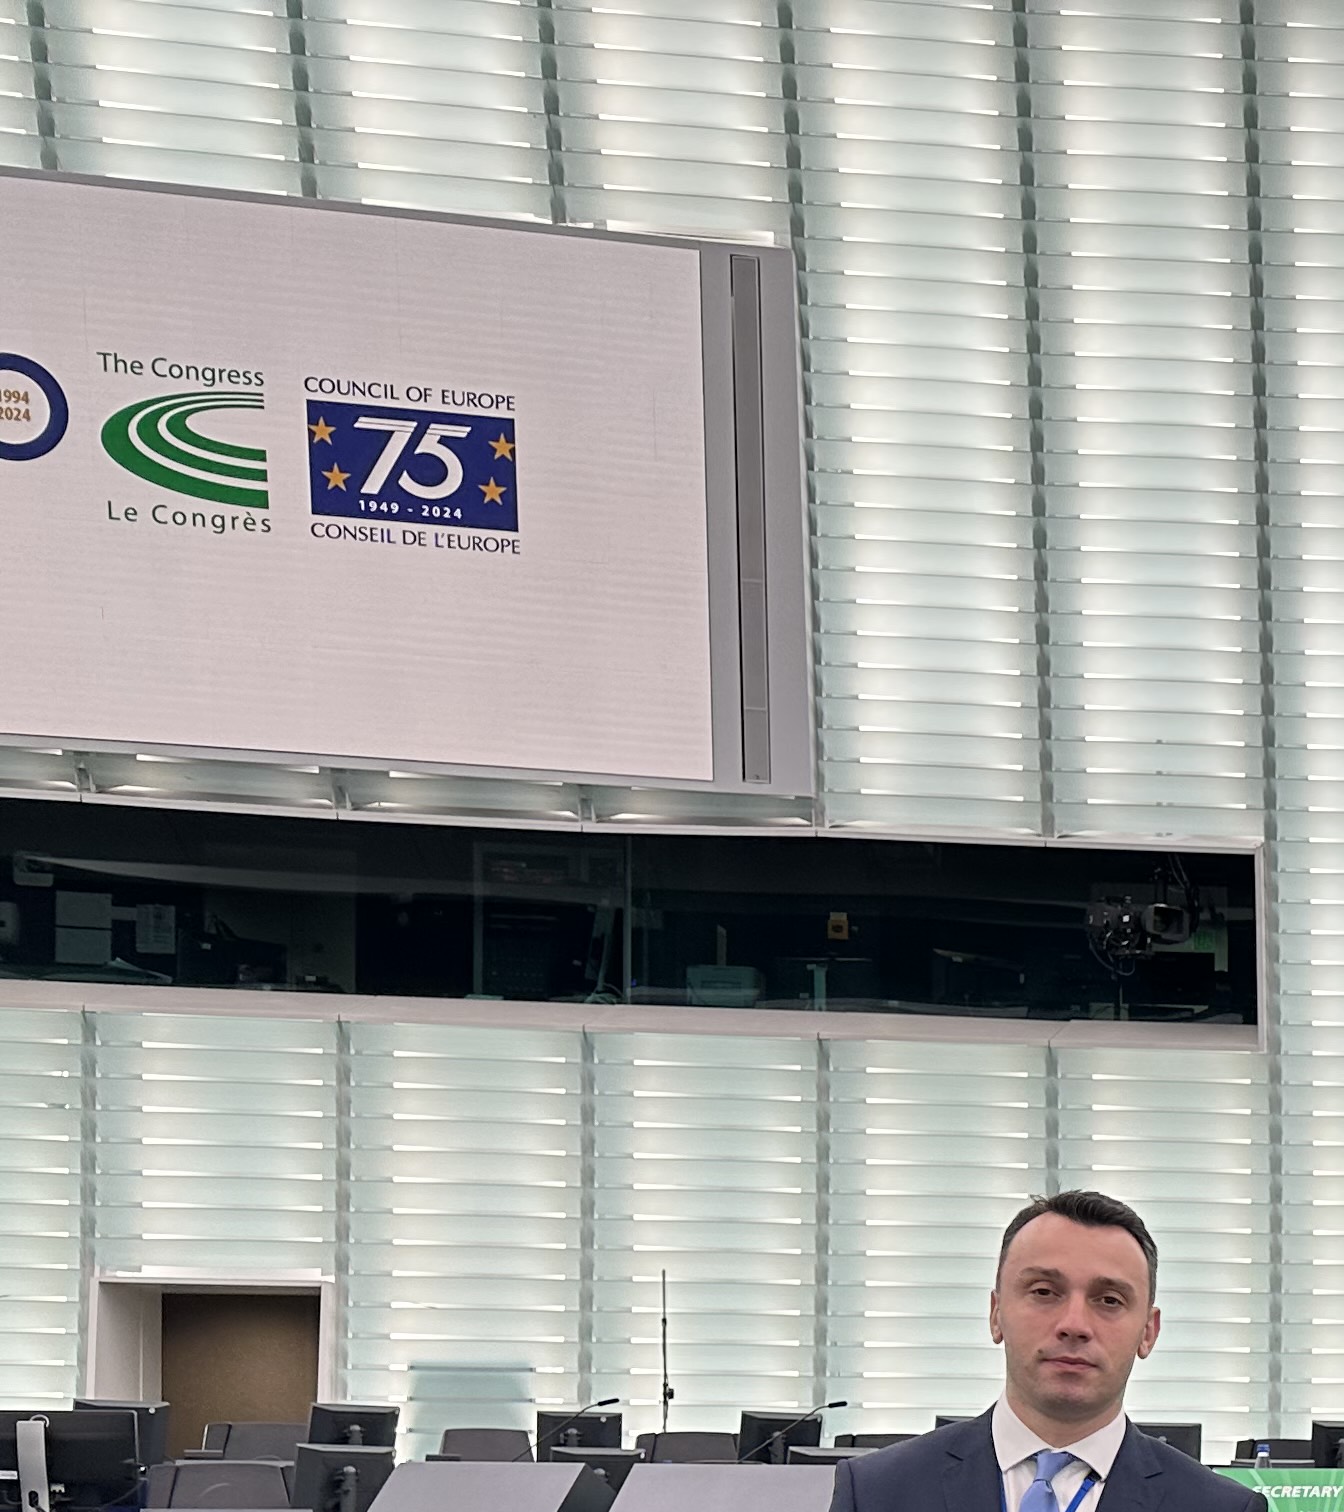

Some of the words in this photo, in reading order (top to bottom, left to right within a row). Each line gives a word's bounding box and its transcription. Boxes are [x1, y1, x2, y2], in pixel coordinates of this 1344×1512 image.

[96, 352, 144, 375] The
[151, 357, 264, 387] Congress
[0, 389, 29, 404] 1994
[304, 377, 399, 400] COUNCIL
[406, 386, 433, 403] OF
[441, 389, 515, 411] EUROPE
[0, 406, 31, 422] 2024
[353, 416, 472, 500] 75
[107, 500, 138, 522] Le
[152, 504, 271, 534] Congrès
[358, 500, 399, 514] 1949
[421, 505, 462, 519] 2024
[310, 522, 396, 544] CONSEIL
[402, 529, 427, 547] DE
[434, 532, 520, 555] L'EUROPE
[1252, 1485, 1343, 1498] SECRETARY
